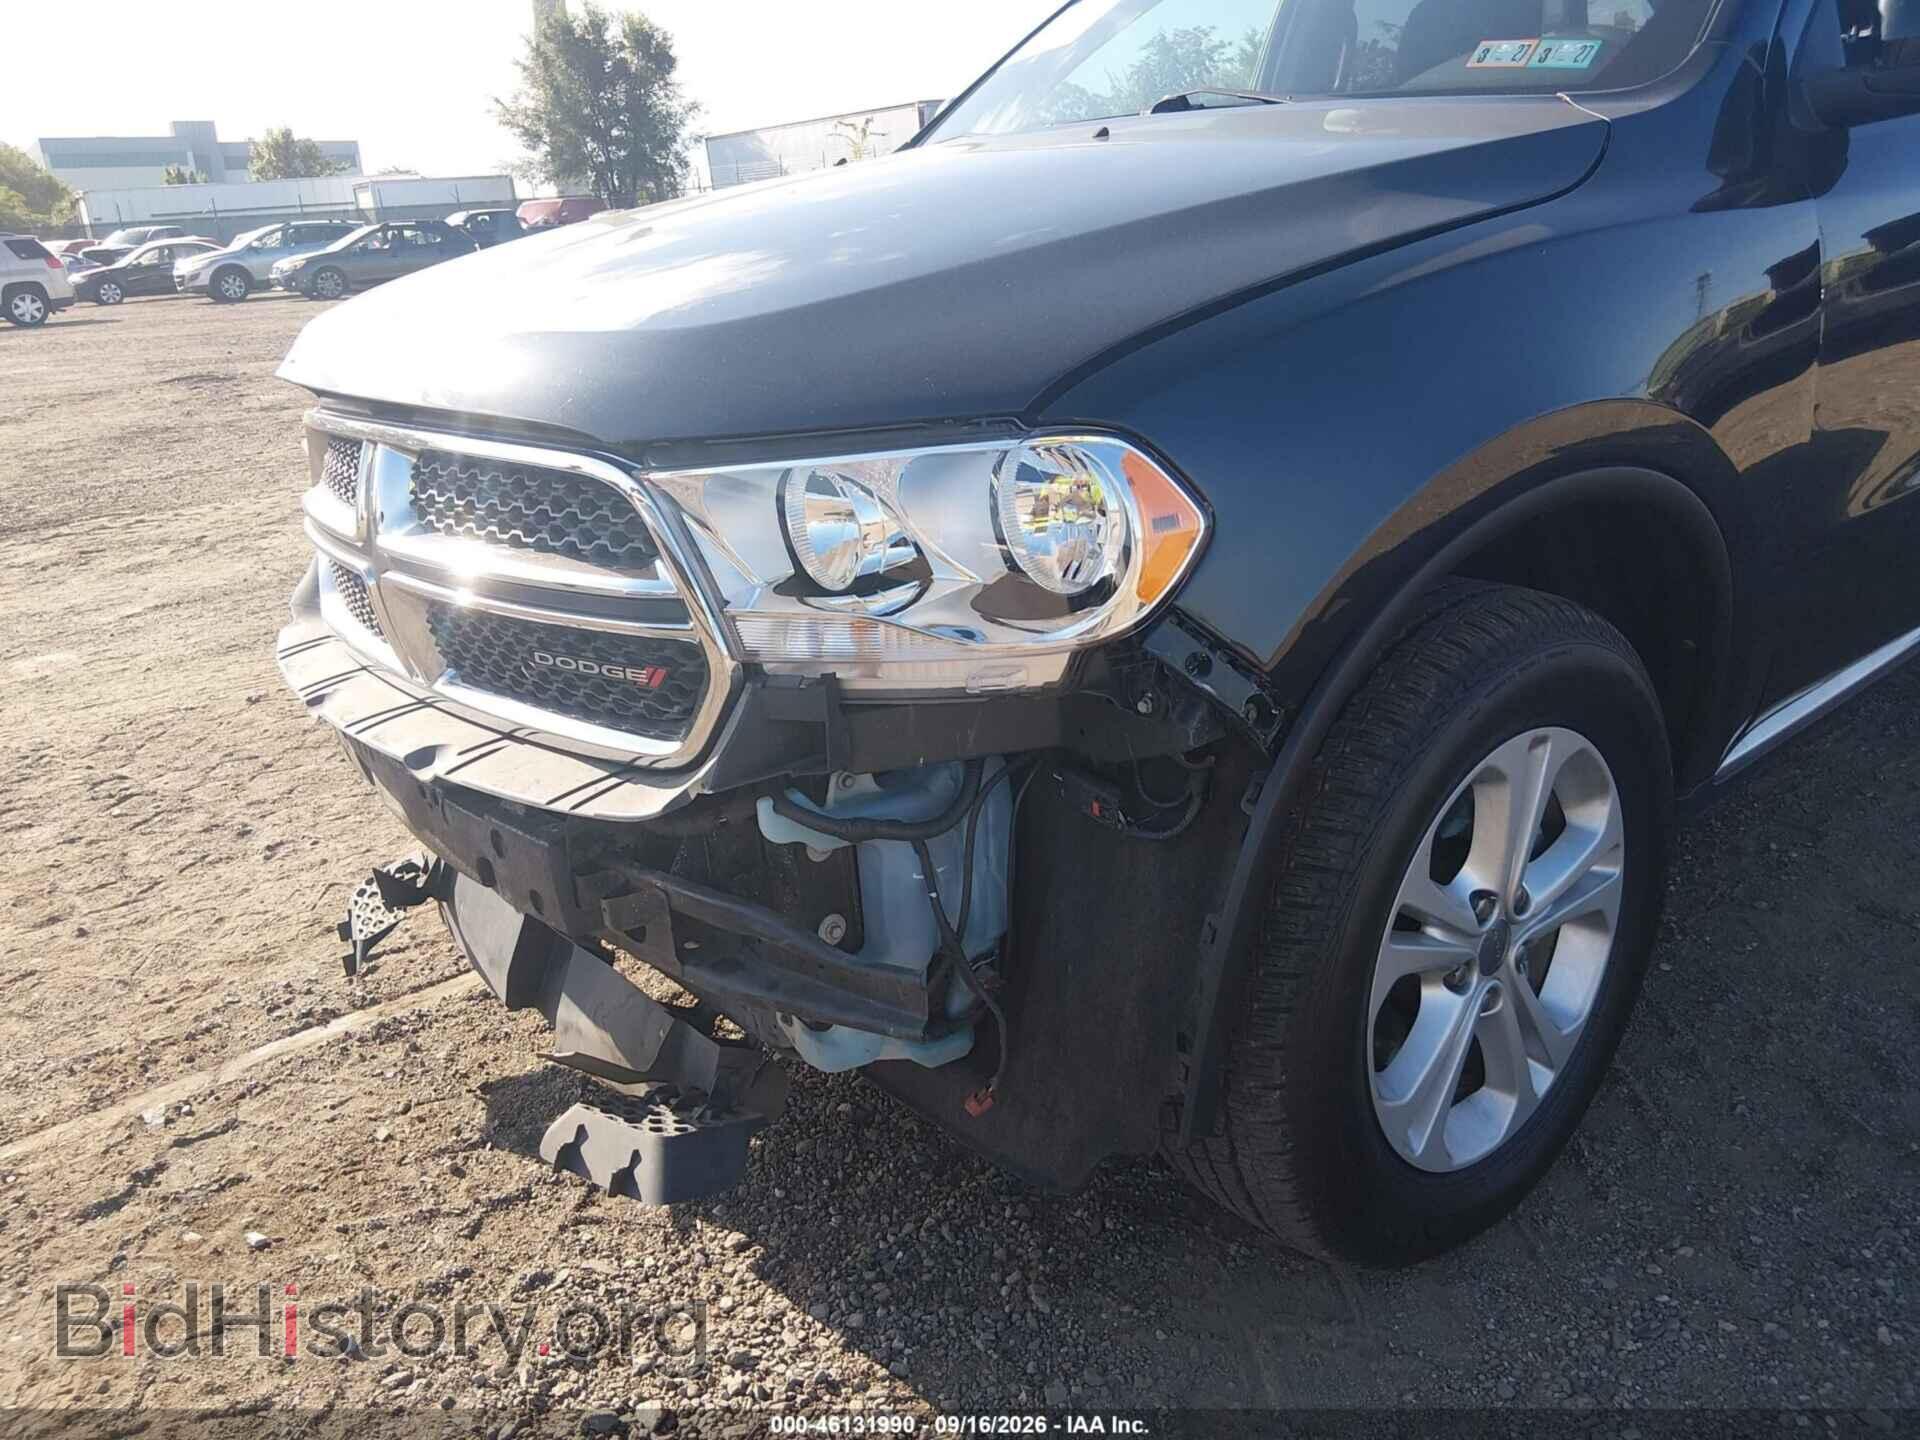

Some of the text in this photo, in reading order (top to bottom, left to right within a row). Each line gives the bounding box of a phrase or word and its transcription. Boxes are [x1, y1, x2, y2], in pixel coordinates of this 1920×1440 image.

[1511, 44, 1532, 63] 27
[1573, 44, 1594, 63] 27
[533, 651, 649, 683] DODGE
